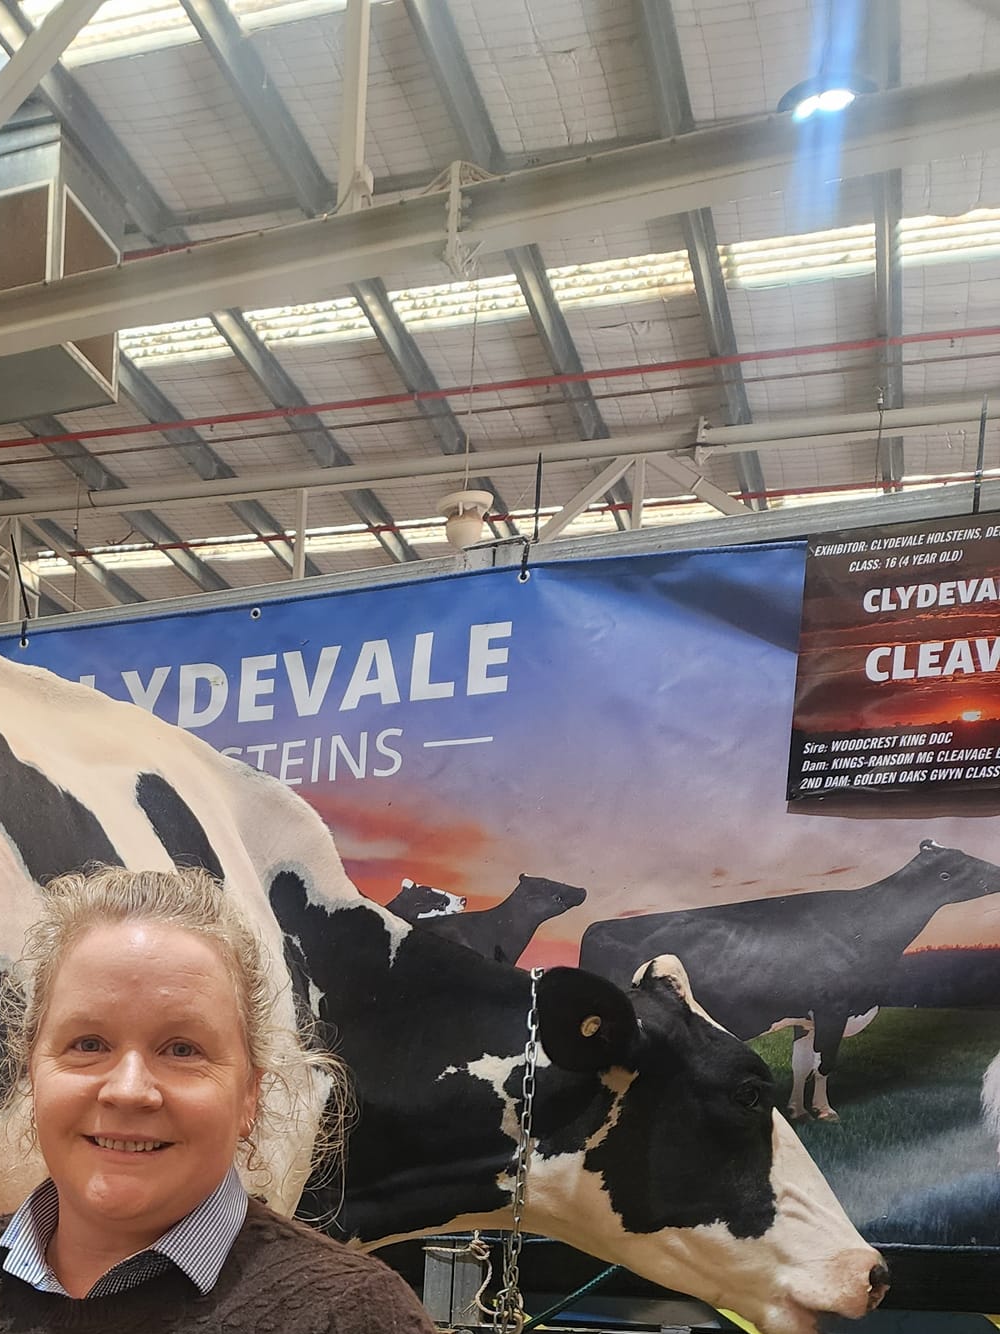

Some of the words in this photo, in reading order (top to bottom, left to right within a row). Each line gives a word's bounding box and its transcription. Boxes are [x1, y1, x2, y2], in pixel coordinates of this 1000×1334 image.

[814, 541, 869, 557] EXHIBITOR:
[870, 534, 926, 551] CLYDEVALE
[926, 527, 983, 545] HOLSTEINS,
[985, 525, 1000, 538] DE
[848, 558, 882, 573] CLASS:
[885, 557, 897, 569] 16
[898, 556, 910, 568] (4
[912, 552, 938, 566] YEAR
[939, 549, 964, 563] OLD)
[863, 577, 1000, 613] CLYDEVA
[79, 621, 513, 729] YDEVALE
[220, 727, 404, 787] TEINS
[803, 742, 828, 755] Sire:
[830, 735, 899, 753] WOODCREST
[899, 733, 927, 748] KING
[928, 731, 954, 746] DOC
[801, 759, 829, 773] Dam:
[830, 752, 915, 771] KINGS-RANSOM
[916, 750, 935, 764] MG
[936, 747, 994, 763] CLEAVAGE
[800, 776, 822, 790] 2ND
[824, 774, 852, 789] DAM:
[853, 771, 898, 787] GOLDEN
[898, 769, 929, 783] OAKS
[929, 767, 964, 782] GWYN
